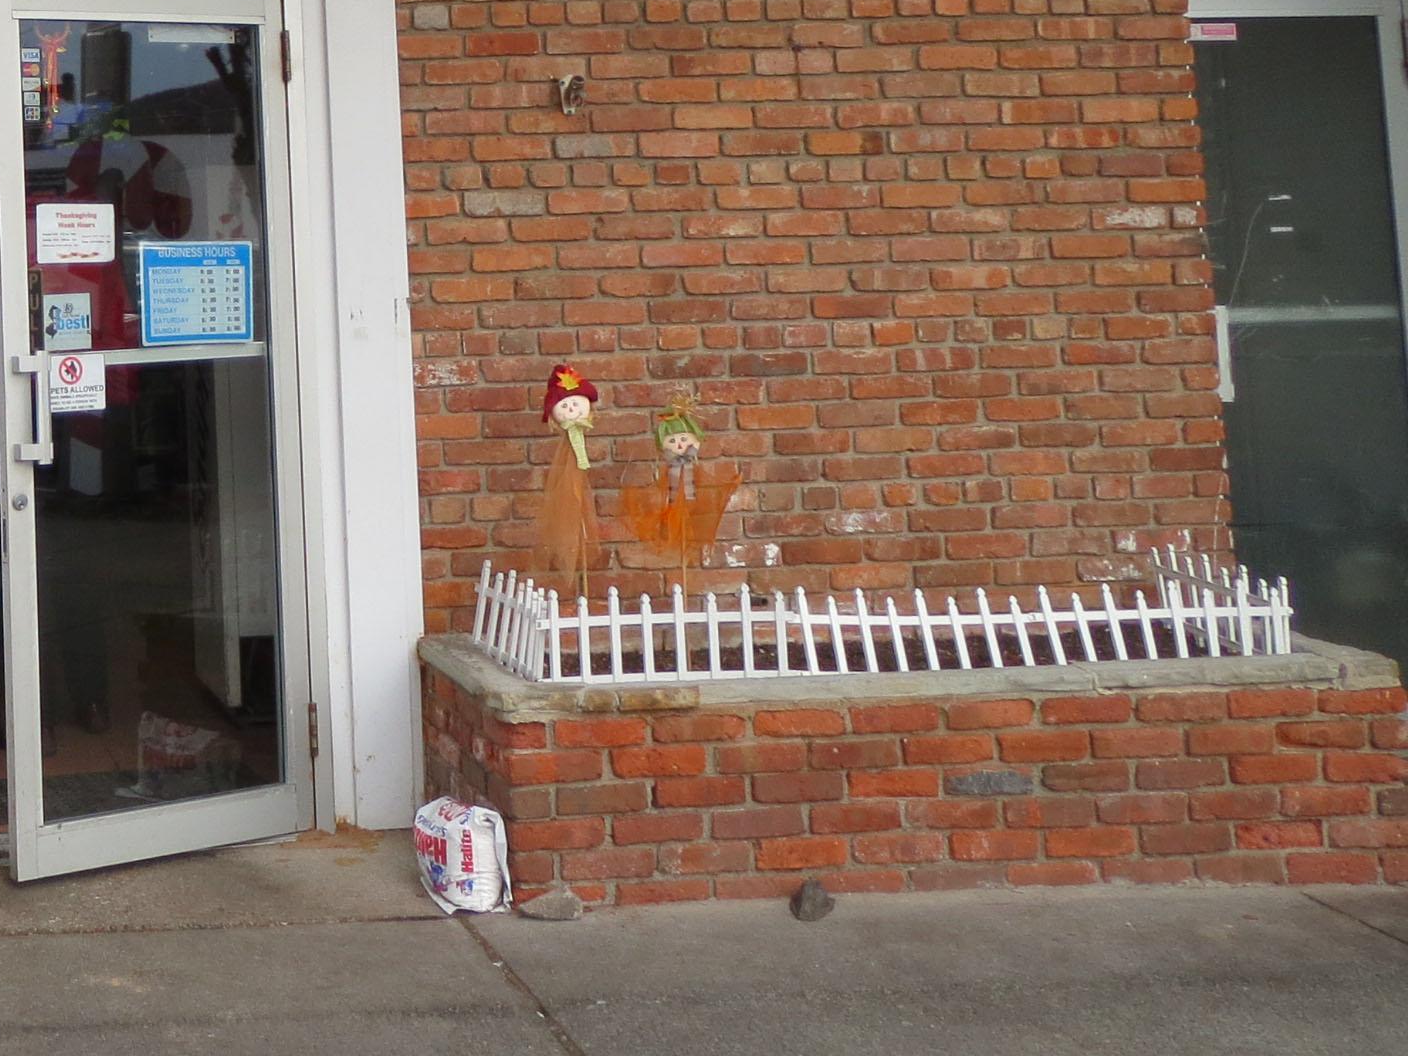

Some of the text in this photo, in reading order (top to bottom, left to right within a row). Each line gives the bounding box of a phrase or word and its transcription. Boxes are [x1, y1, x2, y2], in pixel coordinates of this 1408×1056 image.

[158, 246, 237, 258] BUSINESS HOURS
[71, 384, 104, 393] ALLOWED
